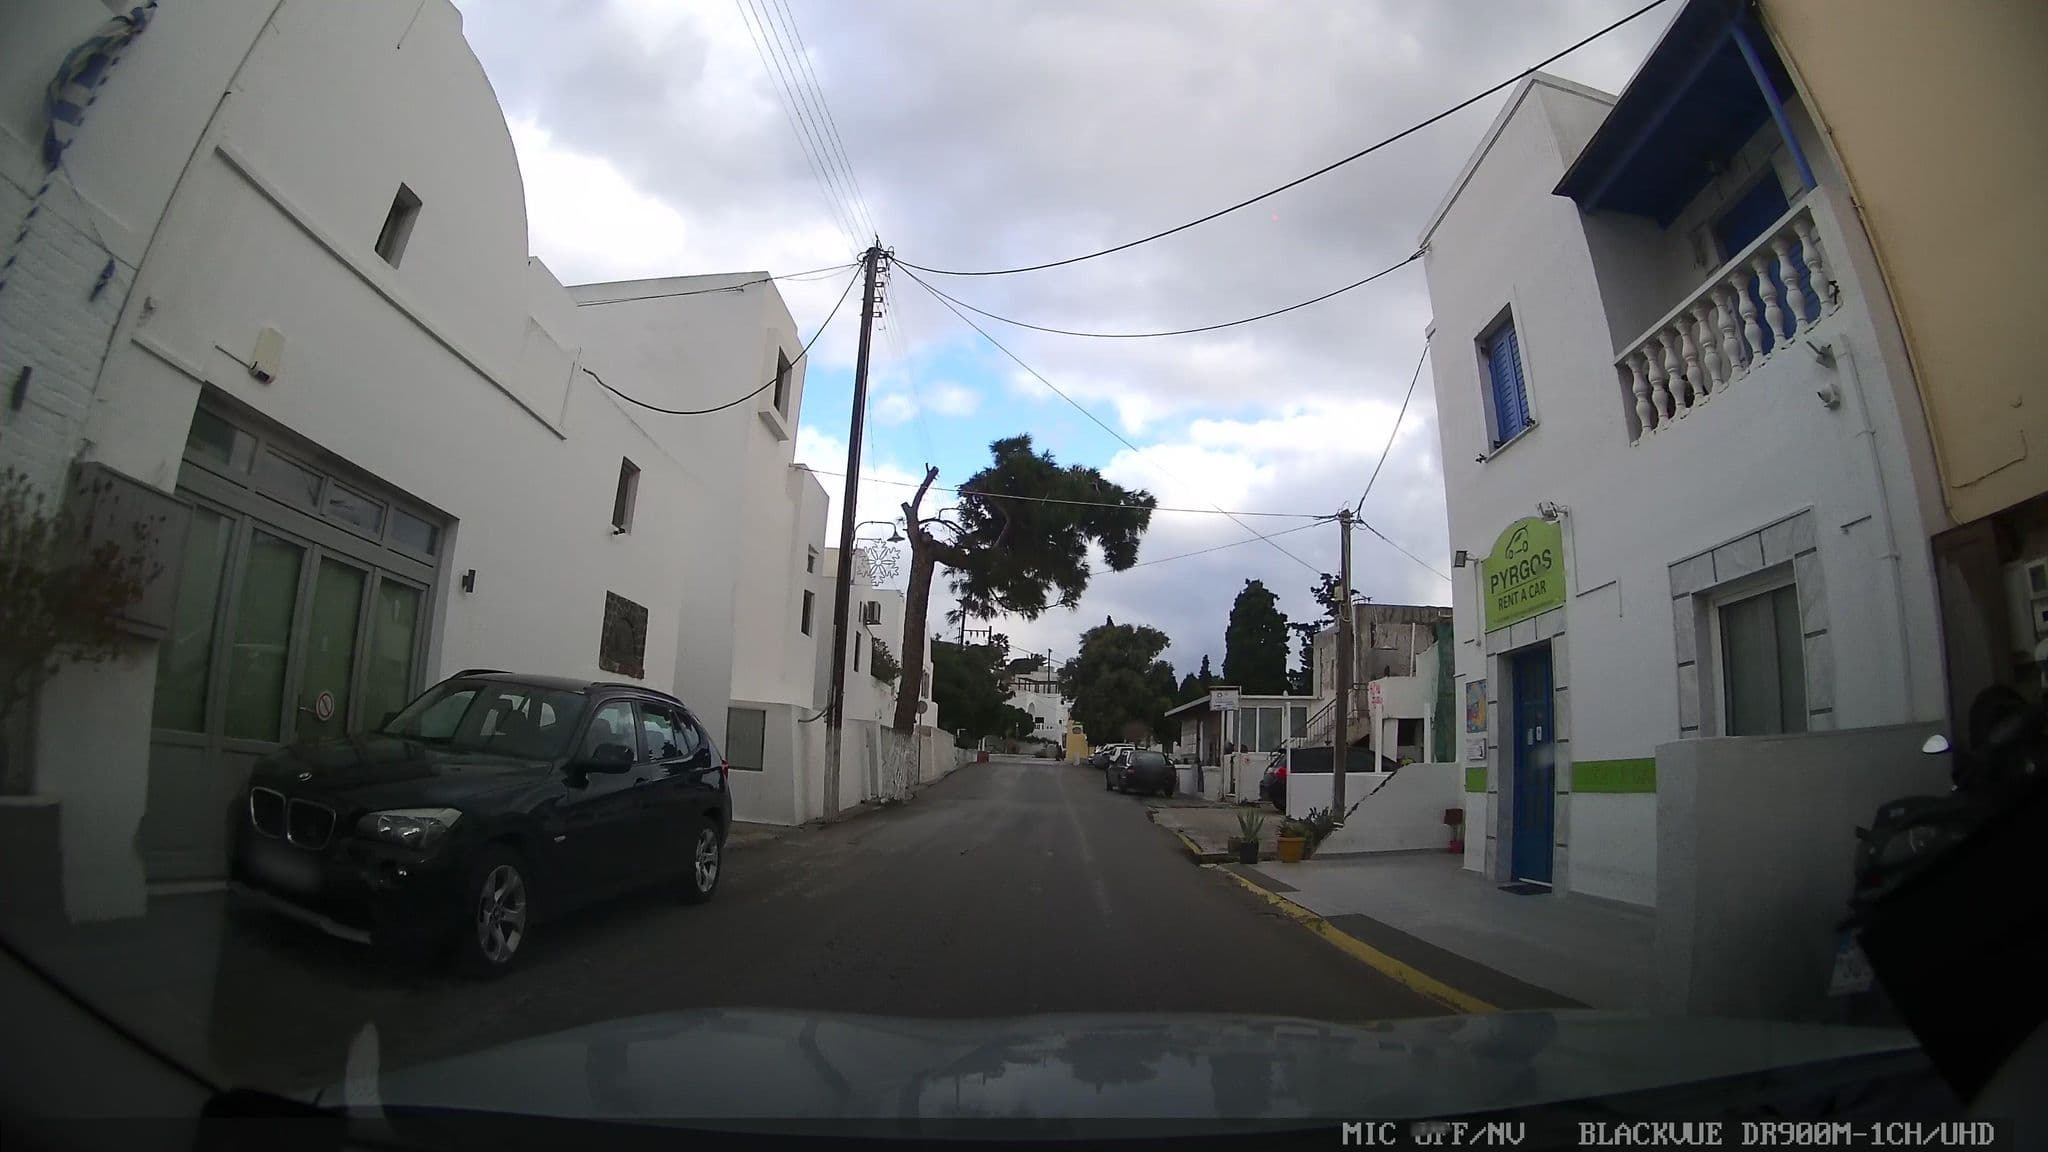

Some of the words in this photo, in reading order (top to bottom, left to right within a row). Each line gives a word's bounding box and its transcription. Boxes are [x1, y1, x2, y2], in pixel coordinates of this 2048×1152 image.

[1491, 549, 1552, 594] PYRGOS
[1499, 591, 1518, 611] RENT
[1521, 589, 1527, 602] A
[1529, 580, 1547, 598] CAR
